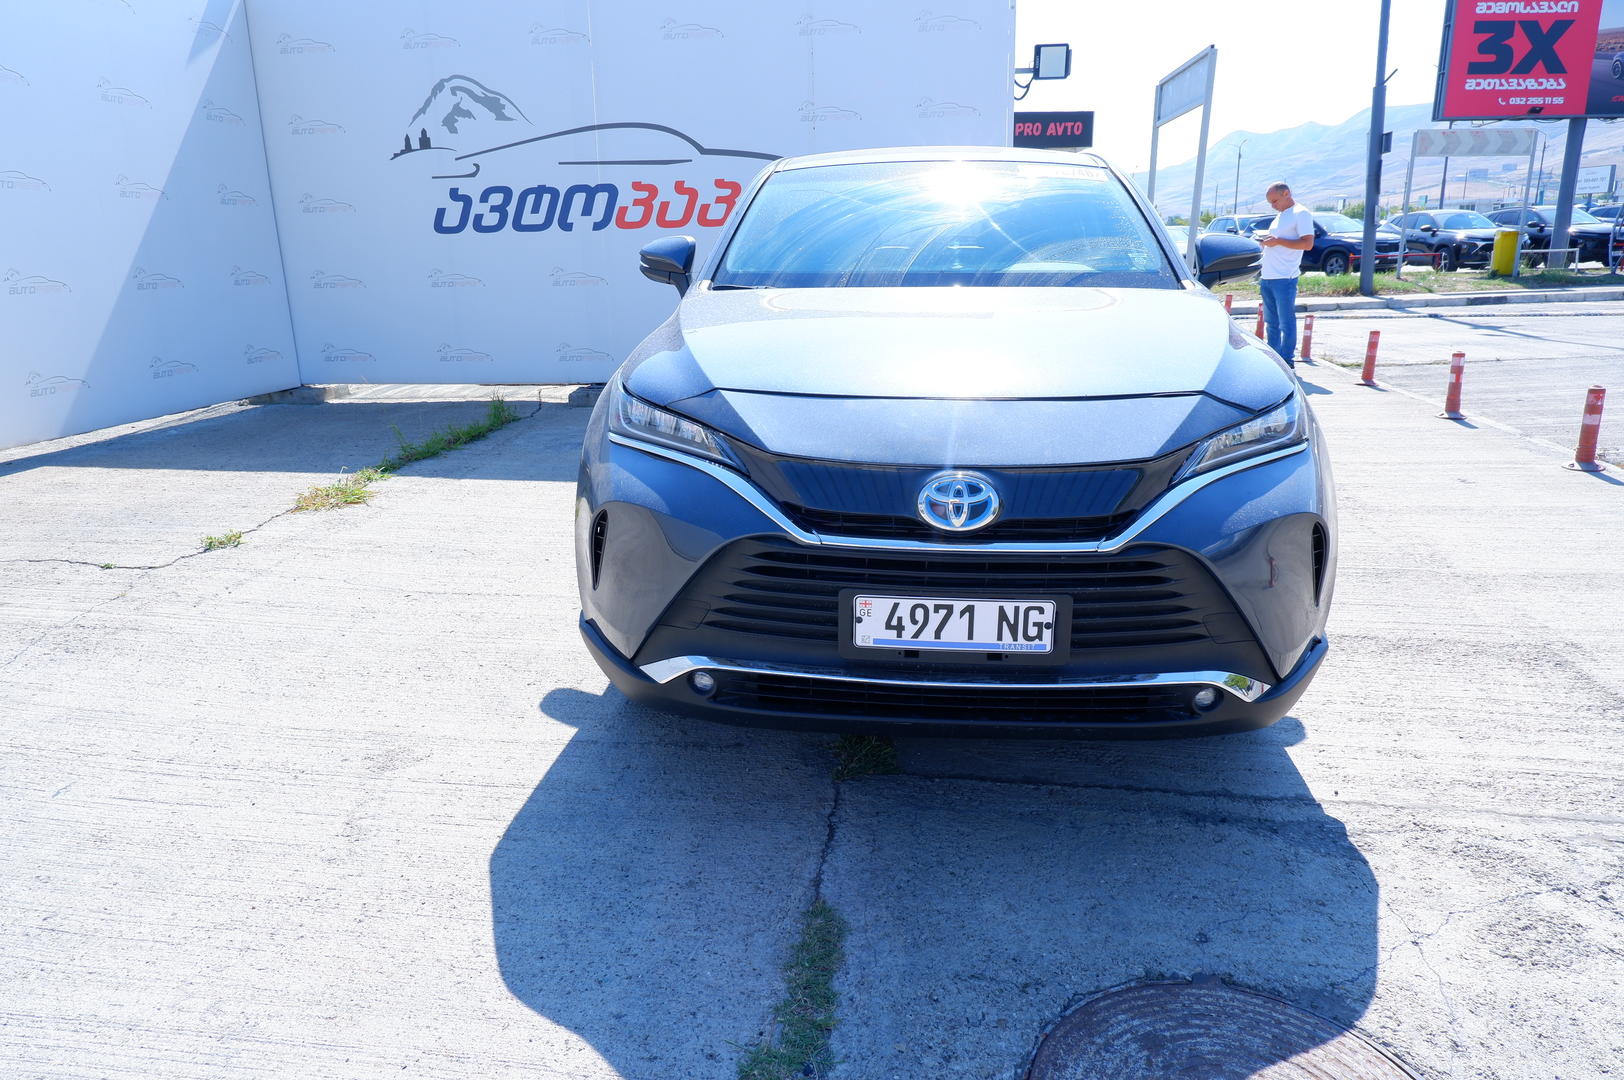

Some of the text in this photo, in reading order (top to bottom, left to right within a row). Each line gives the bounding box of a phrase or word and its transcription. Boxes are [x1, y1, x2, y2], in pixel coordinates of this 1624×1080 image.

[1467, 19, 1576, 75] 3X
[1015, 121, 1083, 136] PRO AVTO
[859, 608, 872, 617] GE
[884, 602, 1045, 643] 4971 NG
[999, 642, 1037, 650] TRANSIT
